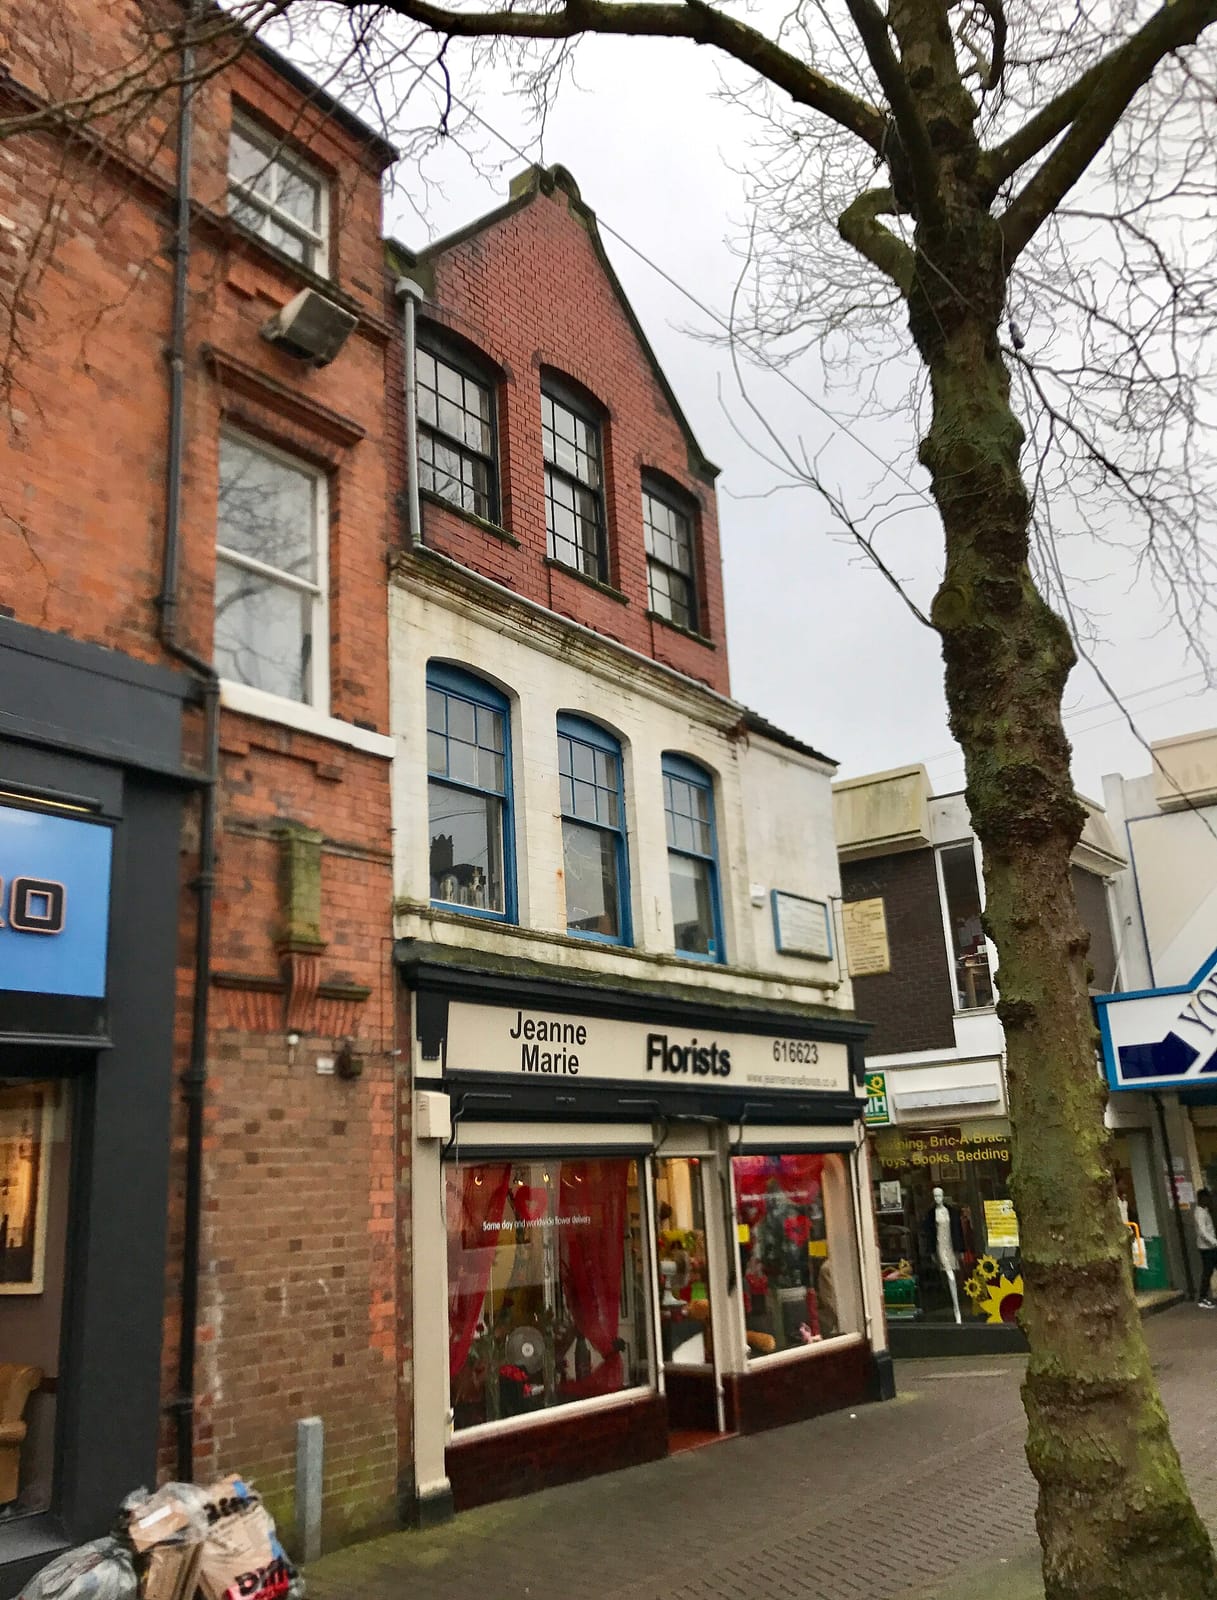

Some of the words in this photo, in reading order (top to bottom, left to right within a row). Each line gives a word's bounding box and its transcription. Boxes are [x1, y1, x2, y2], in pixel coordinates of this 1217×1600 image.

[0, 876, 66, 933] O
[510, 1011, 587, 1046] Jeanne
[522, 1043, 579, 1074] Marie
[647, 1033, 731, 1077] Florists
[773, 1040, 819, 1064] 616623
[912, 1151, 954, 1166] Books,
[956, 1147, 1009, 1163] Bedding
[501, 1219, 513, 1230] day
